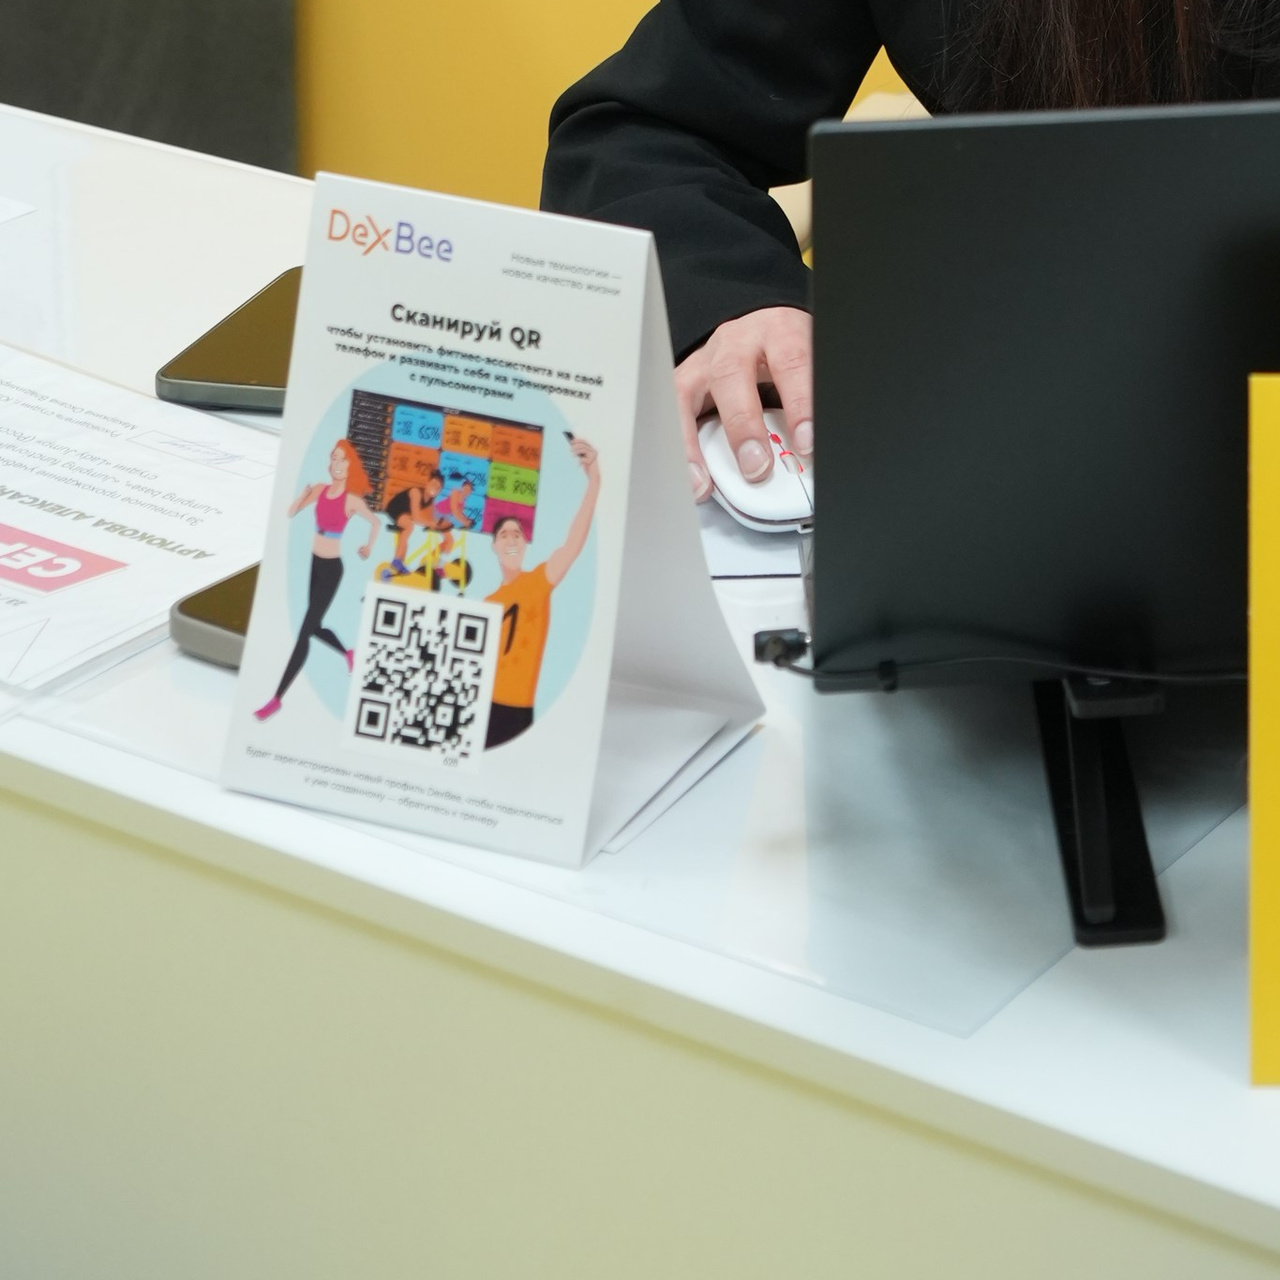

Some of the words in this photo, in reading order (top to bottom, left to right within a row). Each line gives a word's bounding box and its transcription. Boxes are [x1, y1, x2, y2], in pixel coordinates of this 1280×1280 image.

[510, 252, 546, 269] Новые
[548, 259, 610, 279] технологии
[501, 267, 533, 281] новое
[536, 274, 583, 290] качество
[586, 283, 622, 296] жизни
[390, 303, 502, 342] Сканируй
[510, 326, 542, 349] QR
[326, 323, 363, 342] чтобы
[366, 331, 433, 356] установить
[436, 342, 553, 379] фитнес-ассистента
[556, 370, 571, 383] на
[574, 371, 604, 388] свой
[335, 341, 386, 364] телефон
[388, 351, 397, 362] и
[399, 353, 460, 377] развивать
[462, 366, 491, 382] себя
[494, 372, 509, 385] на
[511, 376, 592, 402] тренировках
[409, 372, 417, 383] с
[418, 373, 515, 402] пульсометрами
[35, 469, 121, 500] прохождение
[112, 462, 158, 480] студии
[120, 496, 187, 521] успешное
[190, 516, 204, 527] За
[91, 518, 215, 560] АРТЮКОВА
[273, 753, 351, 778] зарегистрирован
[352, 770, 383, 785] новый
[384, 778, 426, 795] профиль
[465, 796, 495, 811] чтобы
[495, 803, 563, 826] подключиться
[330, 782, 386, 803] созданному
[397, 796, 450, 817] обратитесь
[459, 811, 499, 829] тренеру
